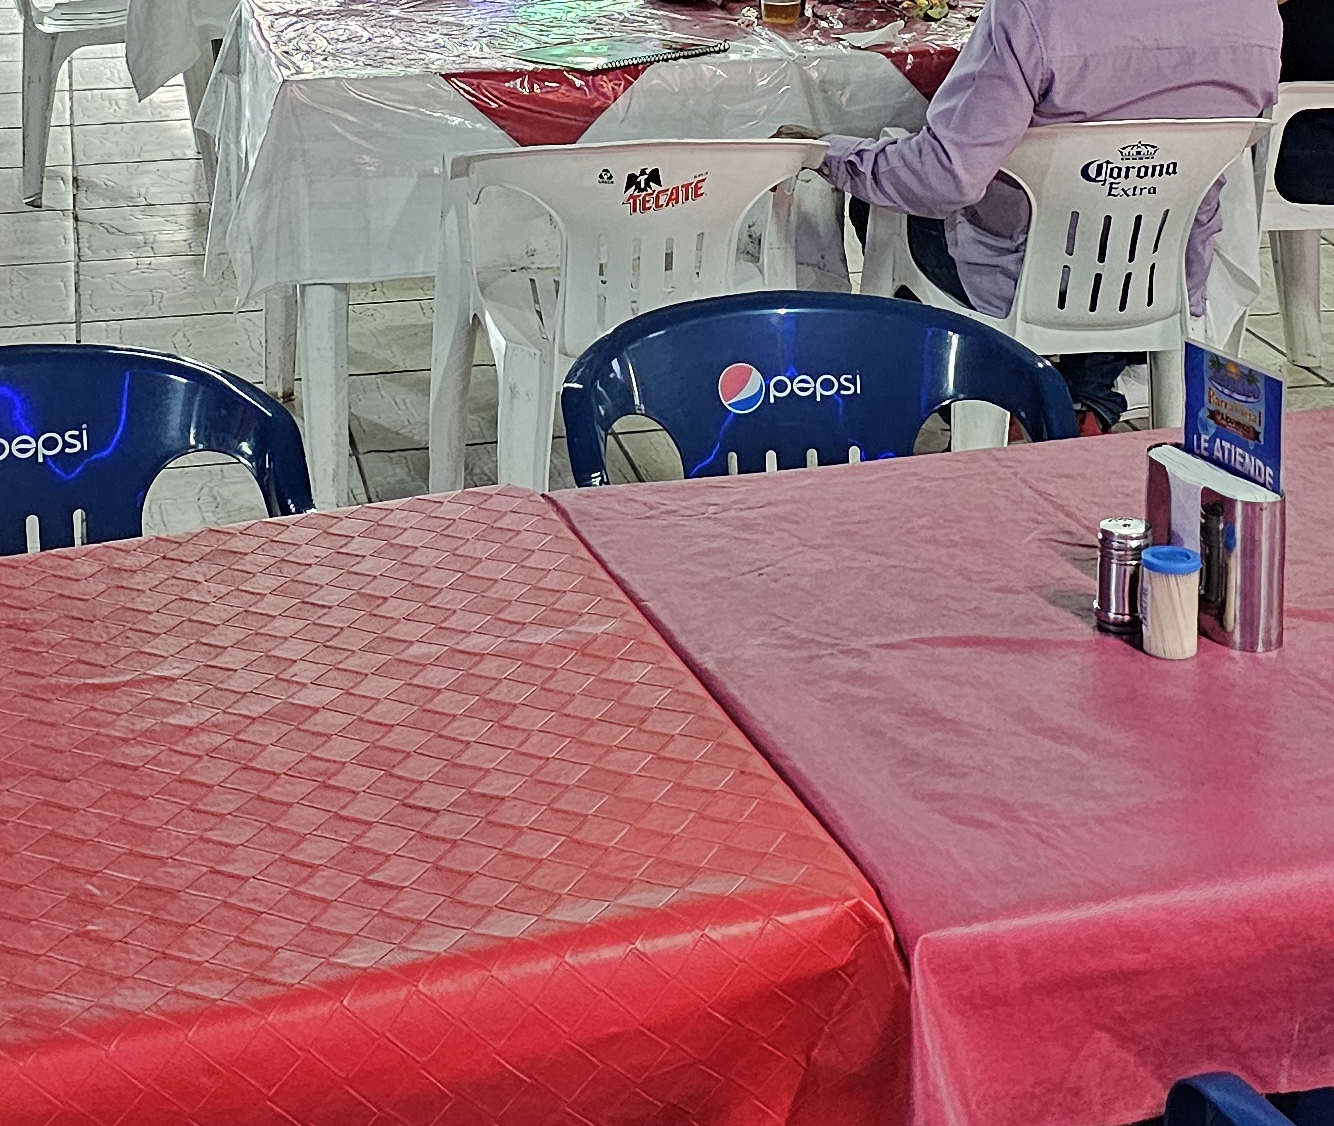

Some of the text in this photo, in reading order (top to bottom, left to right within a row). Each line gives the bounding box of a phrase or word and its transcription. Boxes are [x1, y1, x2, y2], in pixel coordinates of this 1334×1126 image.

[1080, 159, 1178, 186] Corona
[1107, 181, 1157, 197] Extra
[621, 176, 708, 215] TECATE
[769, 369, 862, 404] pepsi
[1193, 433, 1275, 491] LE ATIENDE
